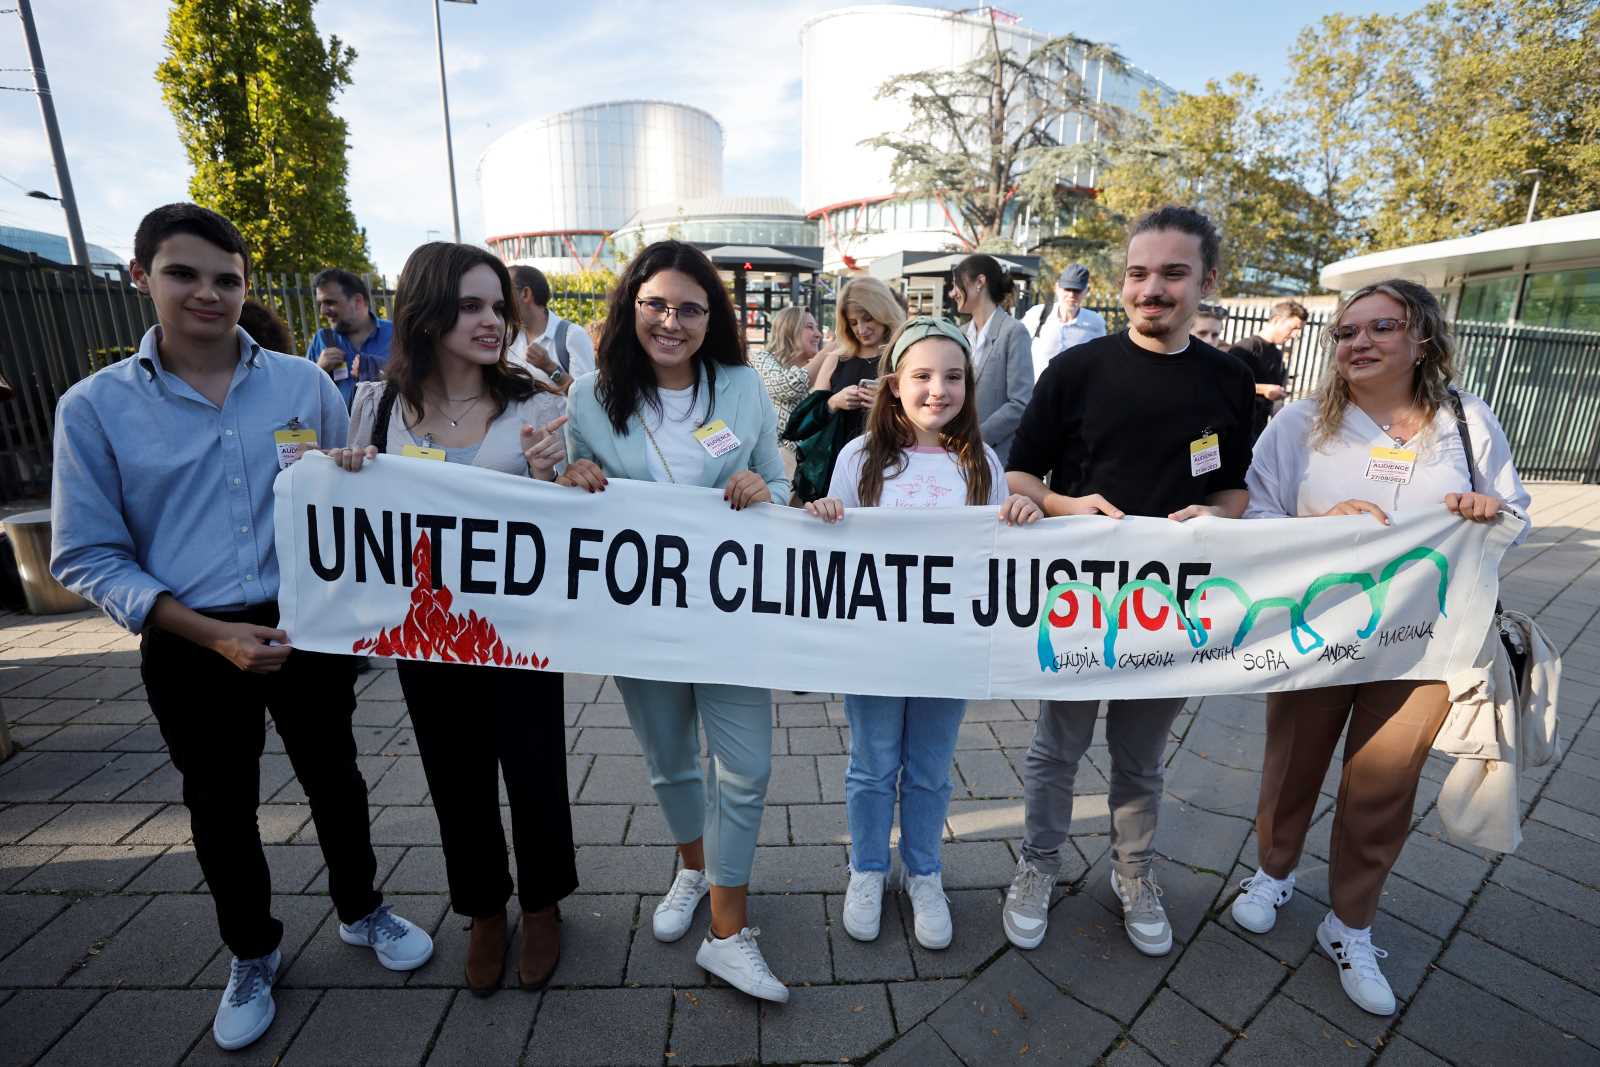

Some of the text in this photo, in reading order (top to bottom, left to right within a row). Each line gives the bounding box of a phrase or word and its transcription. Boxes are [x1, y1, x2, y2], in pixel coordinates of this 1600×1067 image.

[1372, 463, 1409, 471] AUDIENCE
[306, 502, 1212, 632] UNITED FOR CLIMATE JUSTICE
